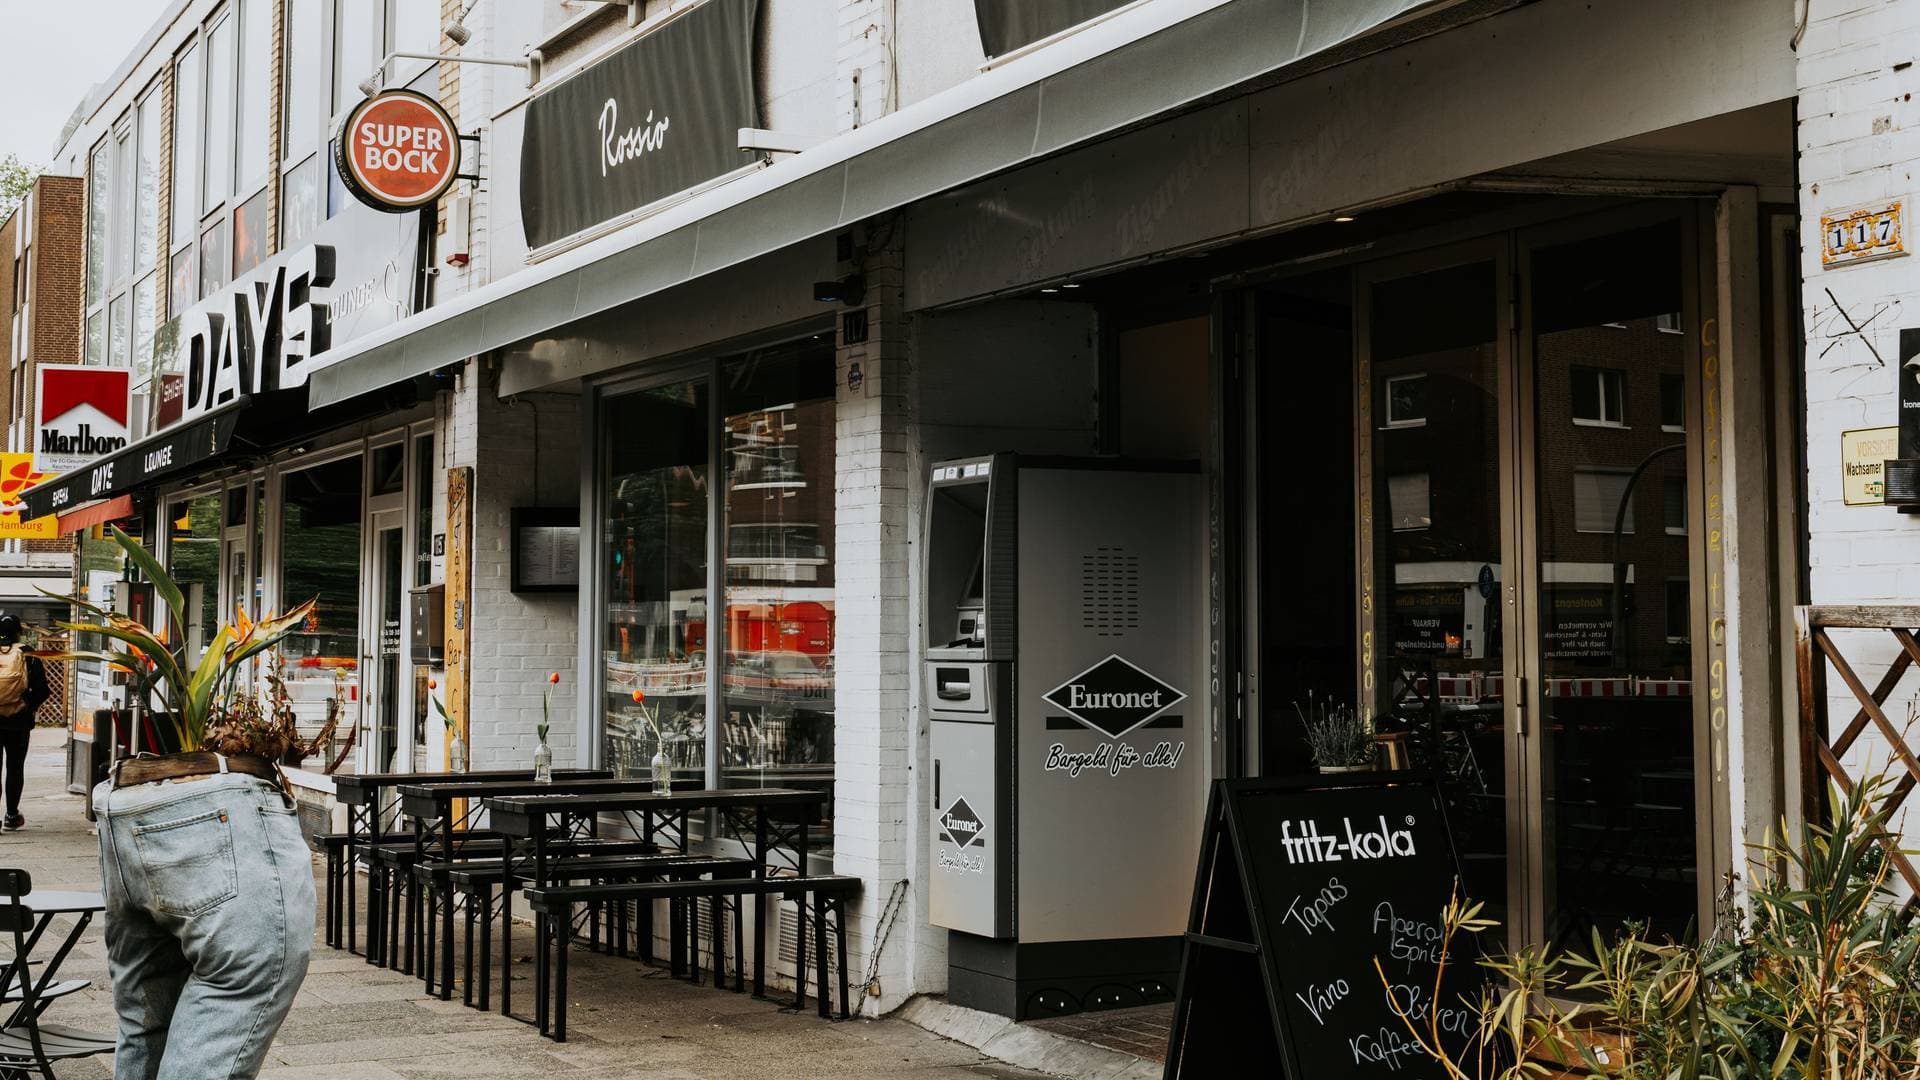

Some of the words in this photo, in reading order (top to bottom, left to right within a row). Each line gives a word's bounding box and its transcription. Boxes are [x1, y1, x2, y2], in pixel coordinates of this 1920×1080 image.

[361, 122, 443, 151] SUPER
[598, 97, 669, 177] Rossio
[365, 146, 439, 174] BOCK
[1833, 219, 1891, 249] 117
[326, 277, 376, 325] LOUNGE
[41, 423, 127, 455] Marlboro
[144, 445, 173, 473] LOUNGE
[1845, 462, 1882, 477] Wachsamer
[447, 638, 462, 667] Bar
[1068, 684, 1162, 709] Euronet
[1045, 742, 1113, 777] Bargeld
[1110, 742, 1140, 777] für
[1143, 741, 1185, 769] alle!
[946, 812, 978, 833] Euronet
[1281, 815, 1416, 864] fritz-kola
[1281, 876, 1348, 935] Tapas
[1296, 978, 1349, 1026] Vino
[1349, 1027, 1424, 1071] Kaffee
